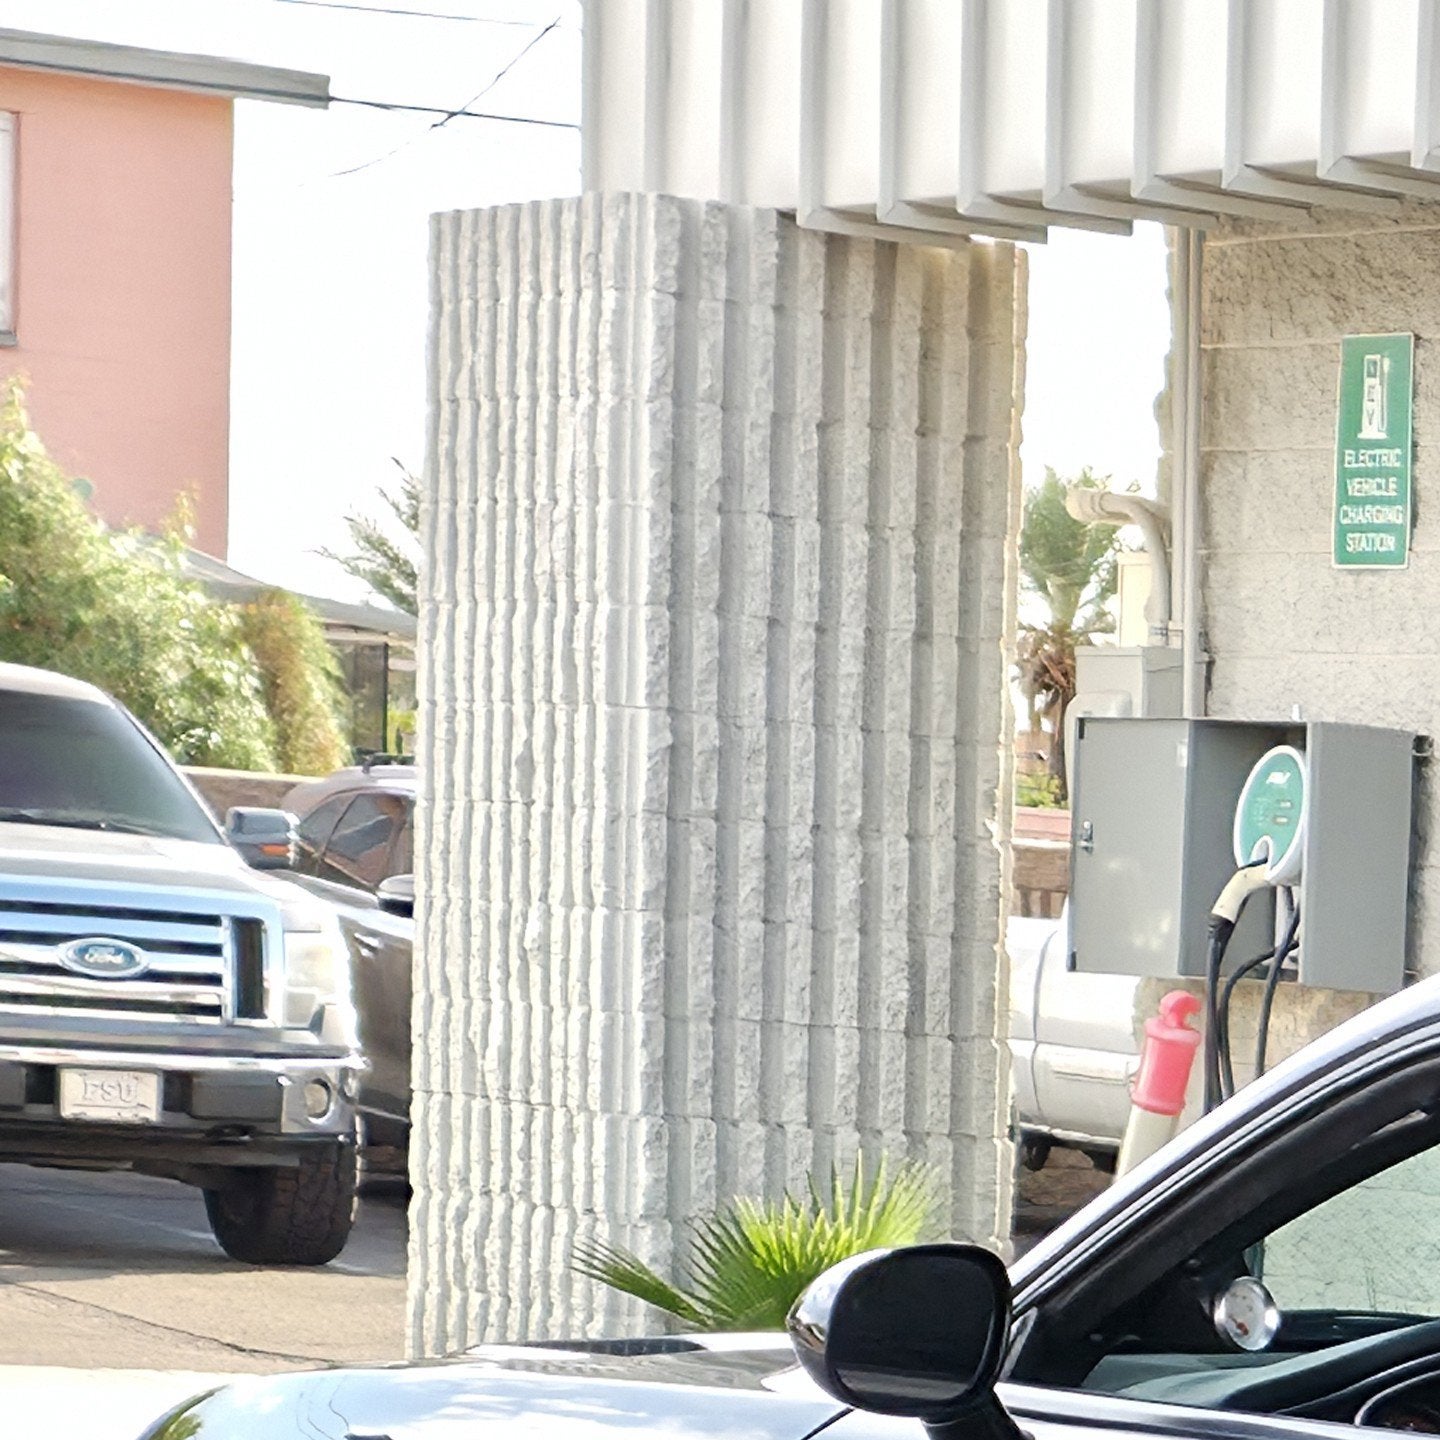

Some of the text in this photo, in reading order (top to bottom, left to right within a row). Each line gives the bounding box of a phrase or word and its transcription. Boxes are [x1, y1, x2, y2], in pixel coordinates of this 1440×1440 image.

[1344, 449, 1402, 467] ELECTRIC
[1346, 477, 1397, 496] VEHICLE
[1340, 505, 1403, 525] CHARGING
[1346, 532, 1396, 551] STATION
